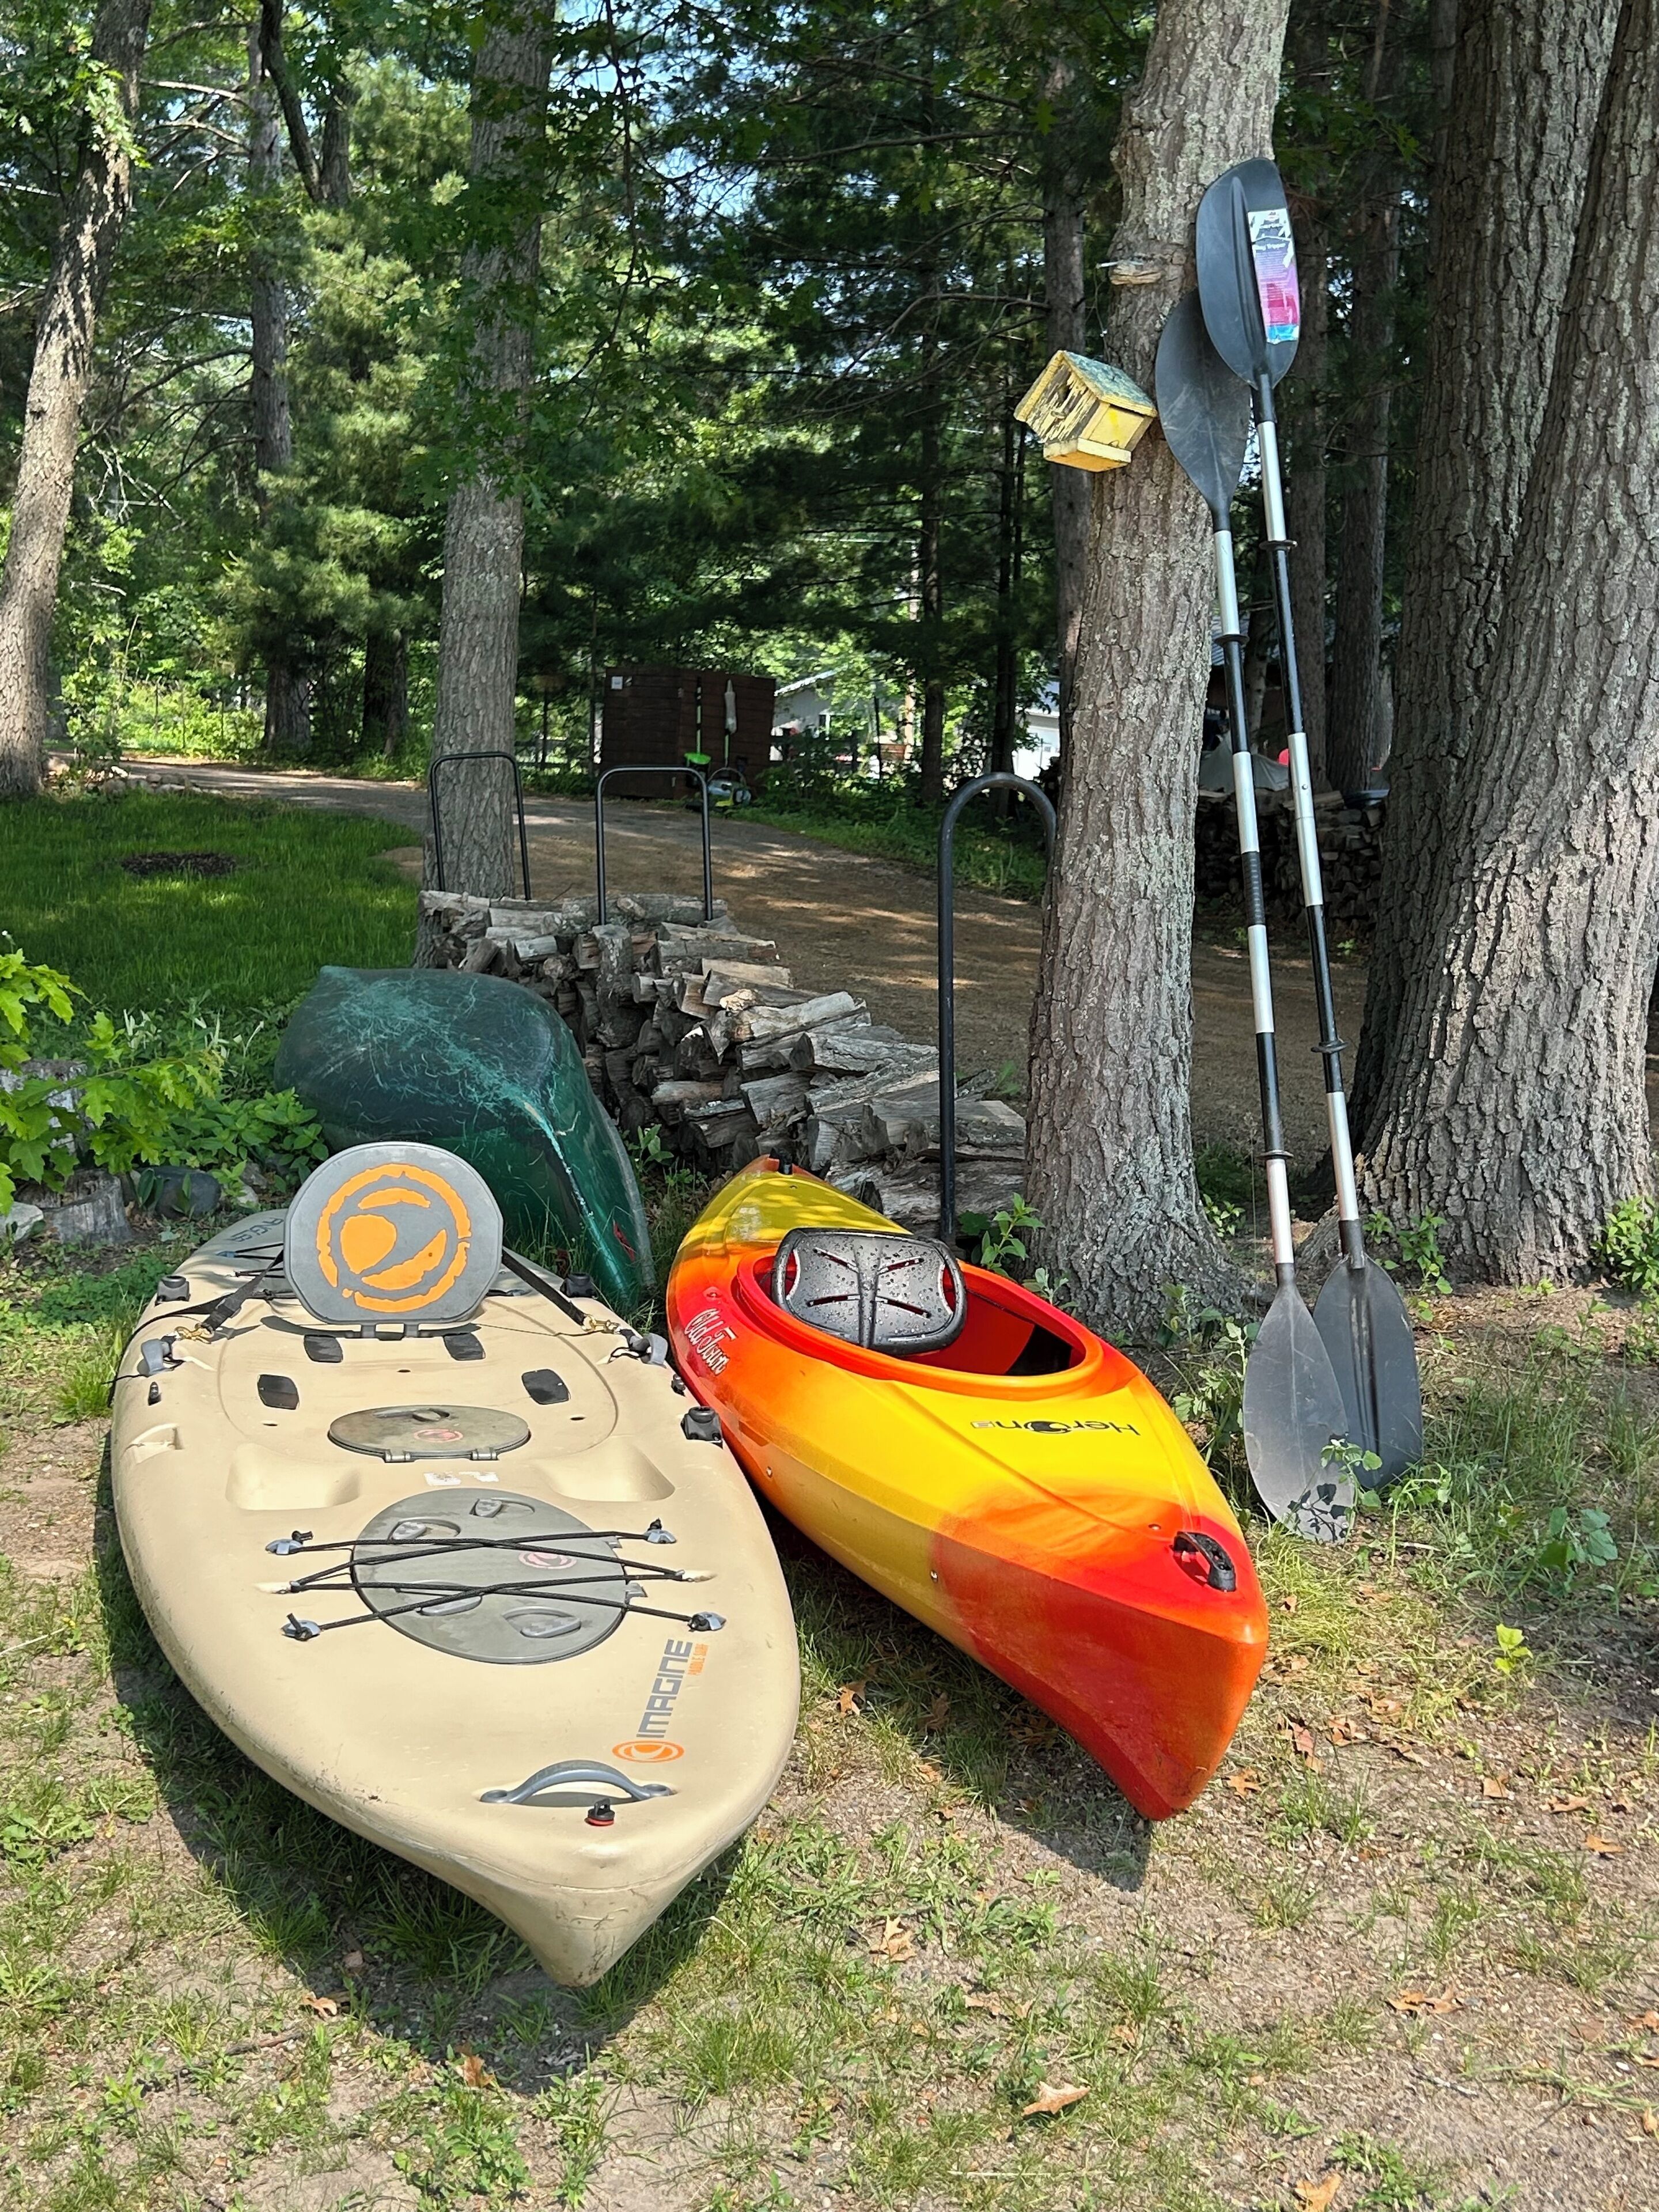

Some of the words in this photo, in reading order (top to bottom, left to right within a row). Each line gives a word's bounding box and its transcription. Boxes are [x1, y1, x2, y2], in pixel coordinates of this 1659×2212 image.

[684, 1308, 724, 1346] Old
[696, 1326, 738, 1376] Town
[636, 1639, 693, 1738] IMAGINE
